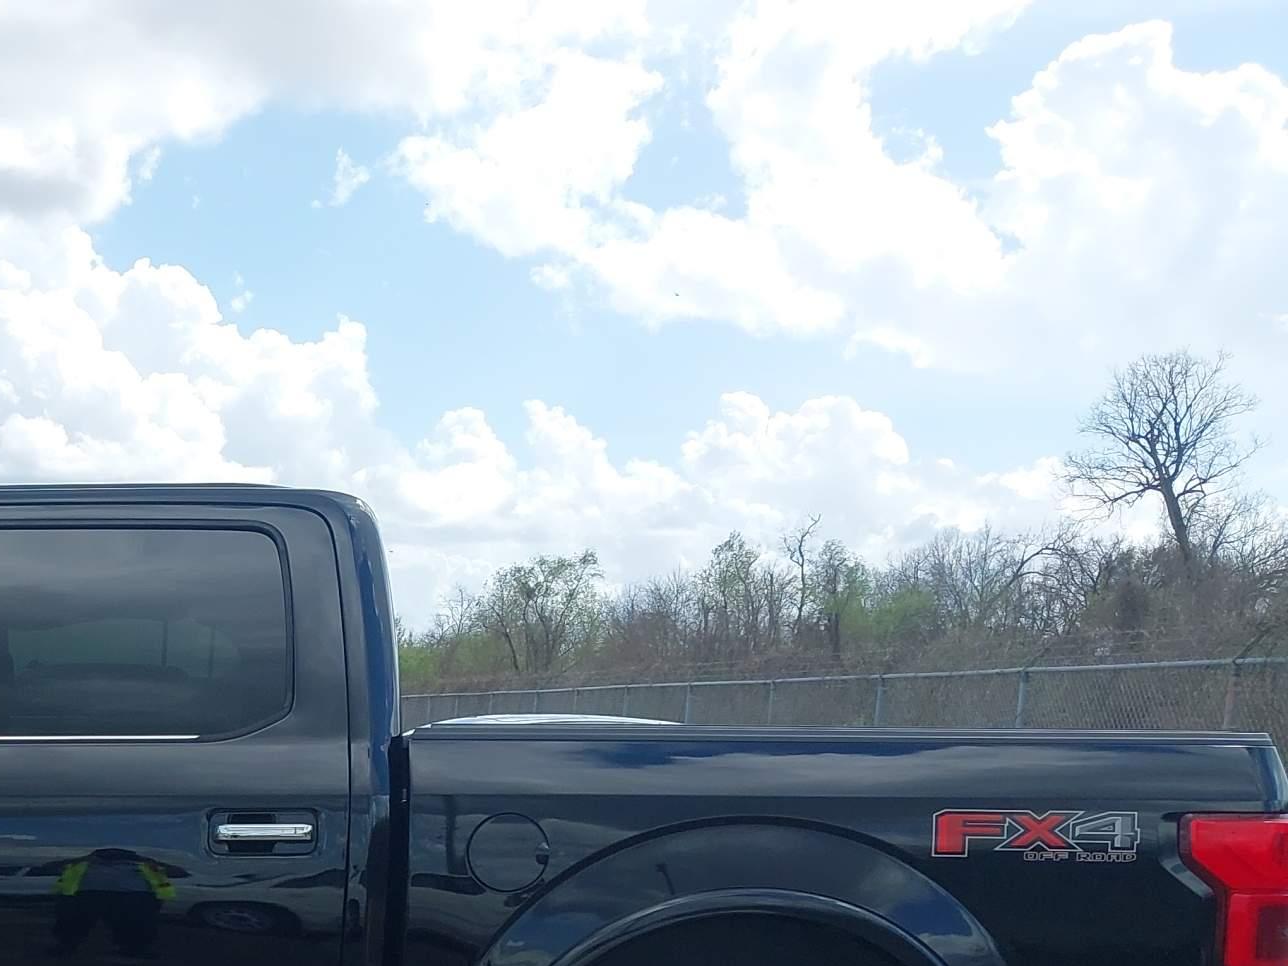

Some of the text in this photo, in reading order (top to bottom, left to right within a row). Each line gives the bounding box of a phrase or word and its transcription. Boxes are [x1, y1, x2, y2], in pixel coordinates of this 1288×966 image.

[931, 808, 1141, 857] FX4
[1023, 851, 1137, 863] OFF ROAD
